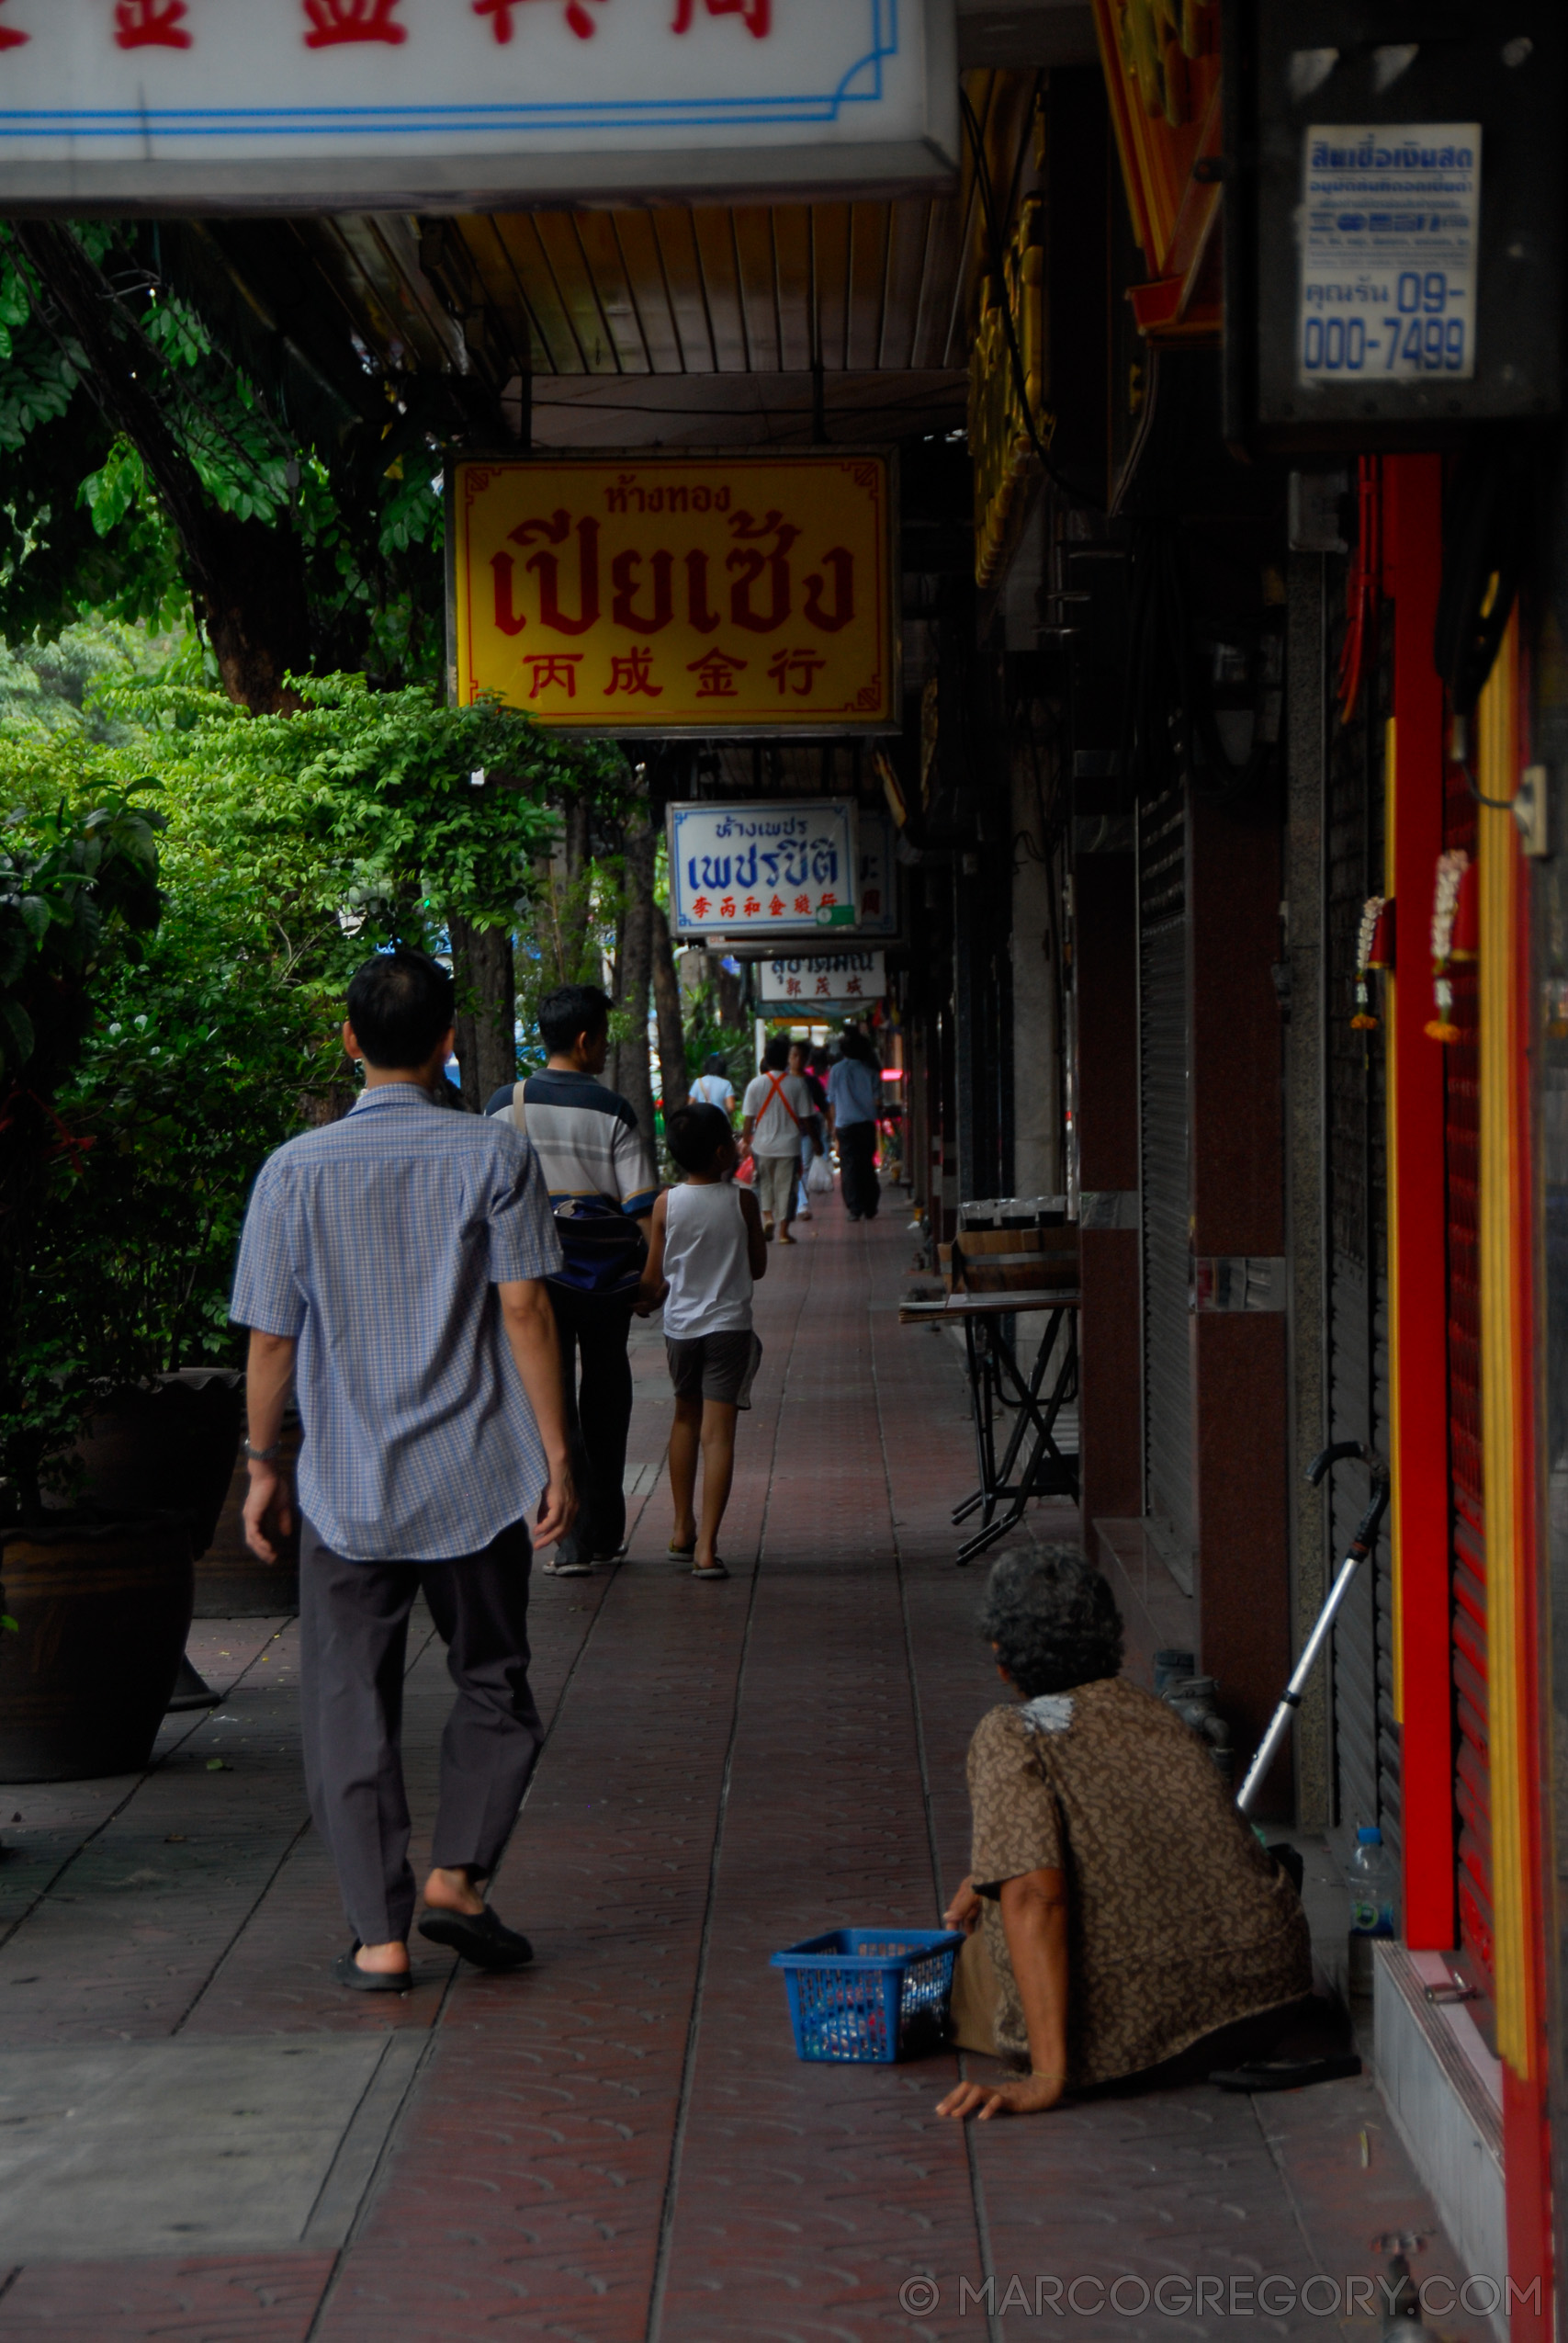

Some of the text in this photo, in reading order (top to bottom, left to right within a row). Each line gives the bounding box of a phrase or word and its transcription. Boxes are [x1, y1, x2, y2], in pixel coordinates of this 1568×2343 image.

[1397, 271, 1465, 313] 09-
[1304, 316, 1464, 369] 000-7499
[604, 474, 731, 513] ห้างทอง
[524, 646, 827, 697] 丙成金行
